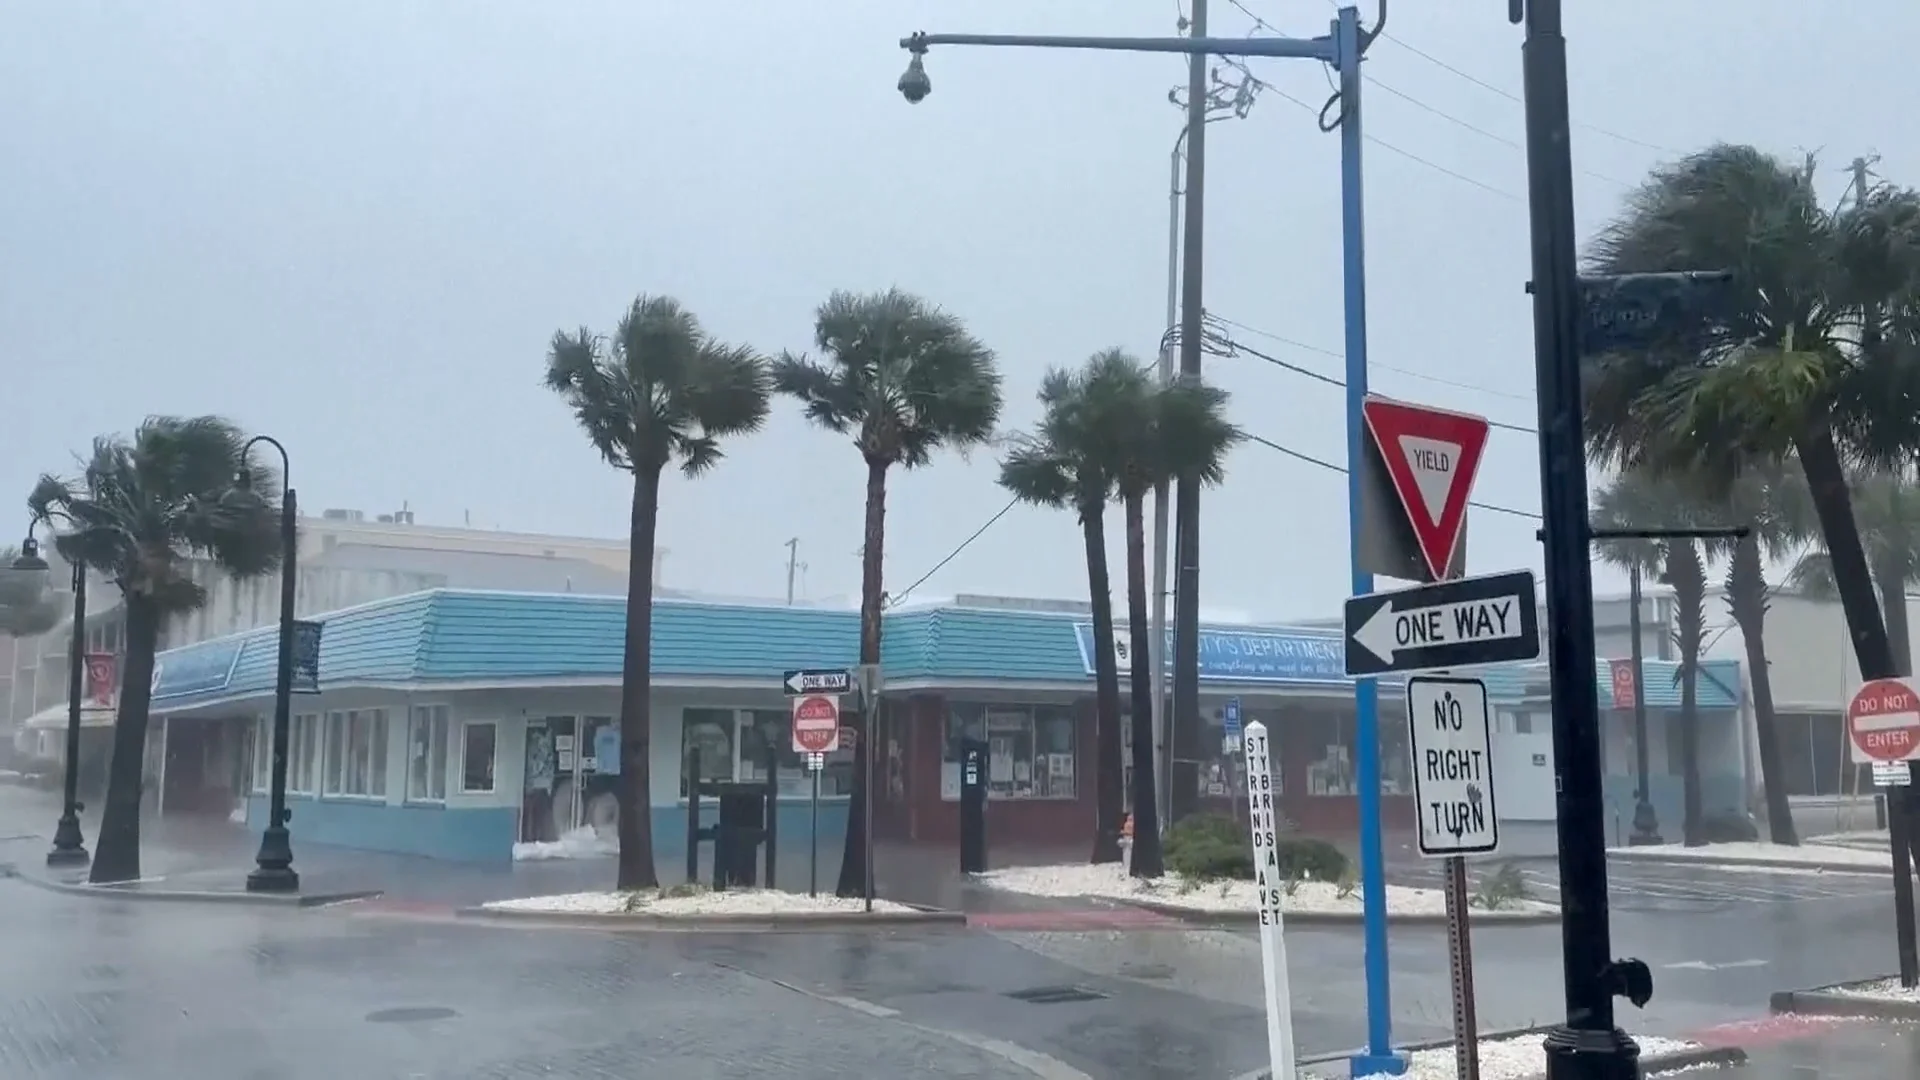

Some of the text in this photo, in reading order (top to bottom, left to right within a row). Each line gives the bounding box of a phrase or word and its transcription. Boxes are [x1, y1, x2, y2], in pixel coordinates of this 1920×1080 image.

[1414, 448, 1449, 472] YIELD
[1395, 601, 1511, 645] ONE WAY
[802, 674, 843, 687] ONE WAY
[1434, 699, 1462, 731] NO
[1860, 694, 1909, 712] DO NOT
[803, 731, 828, 742] ENTER
[1867, 731, 1910, 747] ENTER
[1426, 749, 1481, 781] RIGHT
[1247, 737, 1269, 925] STRAND AVE
[1258, 736, 1280, 925] TYBRISA ST
[1430, 801, 1485, 835] TURN
